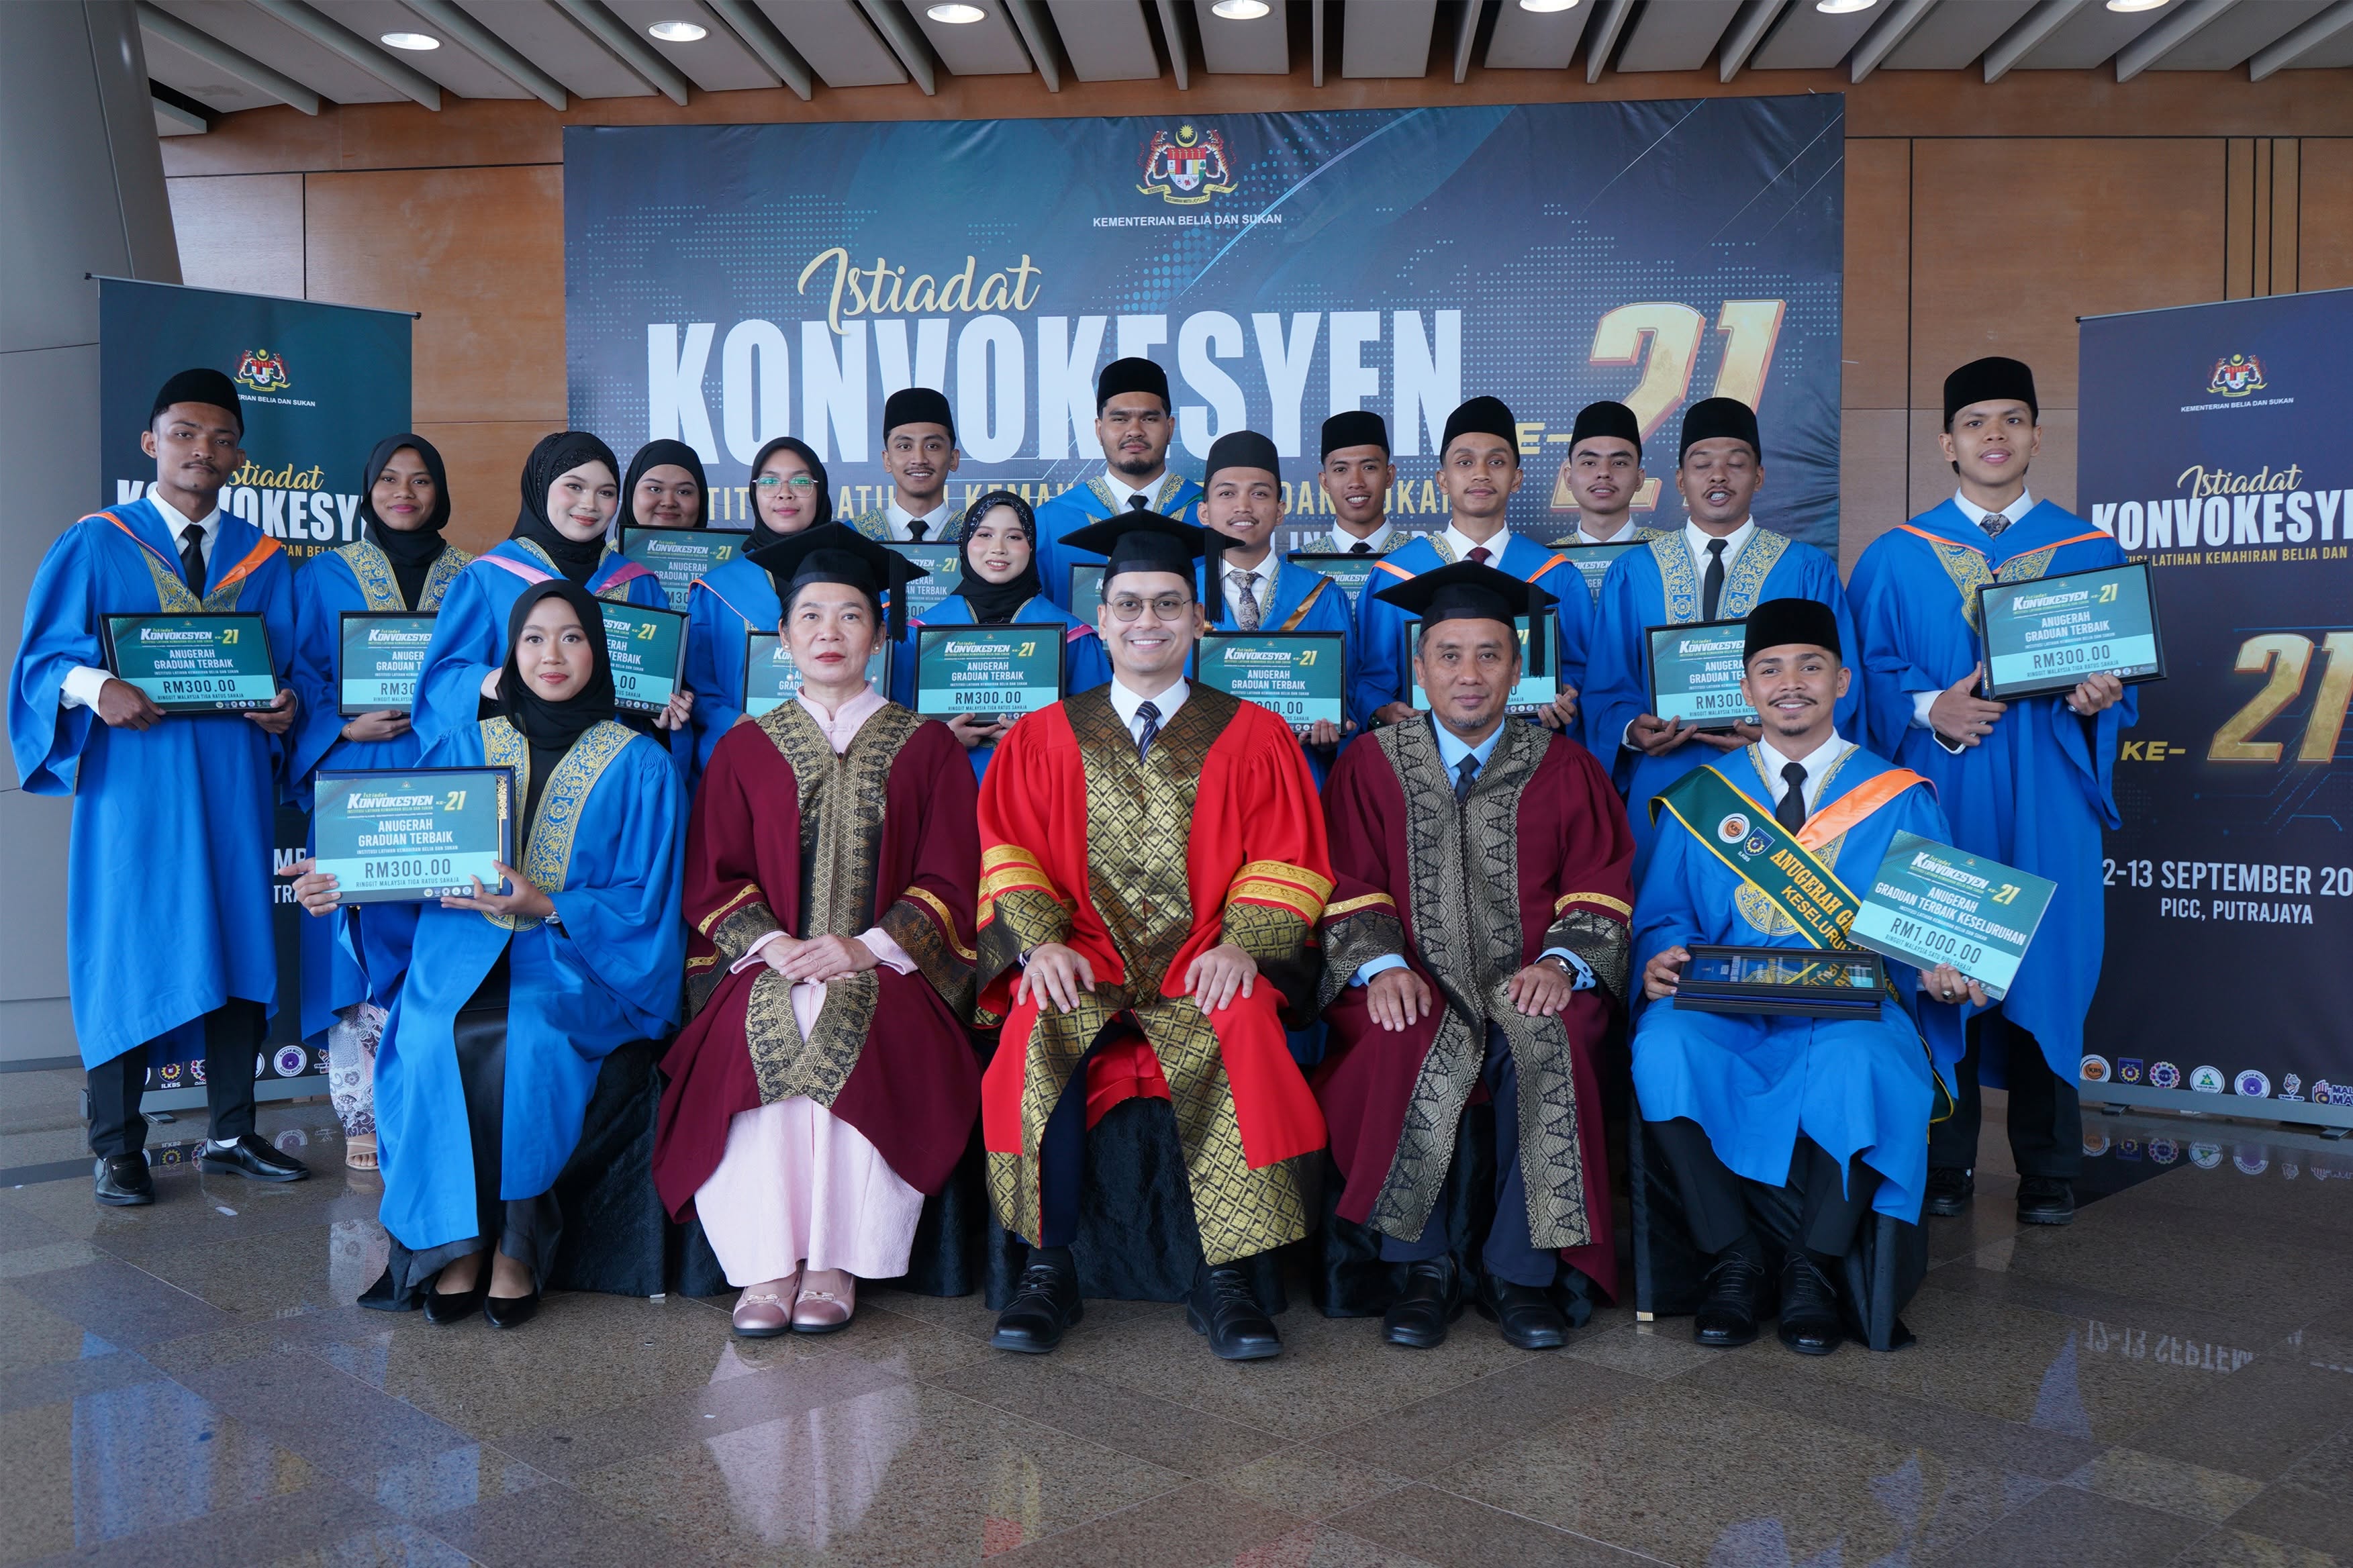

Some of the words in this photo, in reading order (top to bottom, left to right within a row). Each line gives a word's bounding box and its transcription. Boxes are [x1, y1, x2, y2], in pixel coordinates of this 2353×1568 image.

[1093, 216, 1175, 227] KEMENTERIAN
[1178, 215, 1211, 225] BELIA
[1214, 215, 1239, 224] DAN
[1242, 215, 1282, 224] SUKAN
[798, 247, 1041, 336] Istiadat
[2181, 403, 2229, 412] KEMENTERIAN
[229, 460, 325, 491] stiadat
[2177, 464, 2303, 499] Istiadat
[647, 540, 708, 554] KONVOKESYEN
[716, 546, 732, 560] 21
[2152, 551, 2201, 567] LATIHAN
[2206, 549, 2276, 564] KEMAHIRAN
[2283, 548, 2317, 560] BELIA
[2322, 546, 2347, 559] DAN
[668, 562, 707, 572] ANUGERAH
[942, 557, 958, 572] 21
[917, 586, 947, 595] TERBAIK
[2013, 591, 2088, 611] KONVOKESYEN
[2099, 583, 2119, 603] 21
[2042, 611, 2091, 628] ANUGERAH
[140, 628, 212, 640] KONVOKESYEN
[223, 629, 239, 644] 21
[638, 623, 657, 640] 21
[2025, 626, 2068, 642] GRADUAN
[2070, 620, 2109, 636] TERBAIK
[607, 639, 628, 651] ERAH
[945, 642, 1010, 653] KONVOKESYEN
[1018, 642, 1036, 656] 21
[170, 649, 215, 659] ANUGERAH
[392, 651, 424, 660] ANUGER
[608, 650, 641, 665] TERBAIK
[1224, 648, 1291, 660] KONVOKESYEN
[1300, 650, 1318, 666] 21
[2033, 644, 2110, 669] RM300.00
[154, 660, 195, 670] GRADUAN
[197, 659, 234, 669] TERBAIK
[377, 662, 414, 671] GRADUAN
[967, 662, 1009, 671] ANUGERAH
[1705, 660, 1745, 671] ANUGERA
[2048, 667, 2071, 675] MALAYSIA
[952, 672, 988, 681] GRADUAN
[991, 671, 1024, 680] TERBAIK
[1247, 670, 1290, 679] ANUGERAH
[1690, 672, 1729, 683] GRADUAN
[163, 679, 236, 693] RM300.00
[1232, 680, 1269, 689] GRADUAN
[1271, 681, 1305, 689] TERBAIK
[955, 691, 1021, 704] RM300.00
[1696, 693, 1743, 709] RM300
[2121, 741, 2186, 761] KE-
[2207, 632, 2353, 763] 21
[348, 793, 434, 809] KONVOKESYEN
[444, 791, 467, 811] 21
[379, 819, 432, 832] ANUGERAH
[1729, 824, 1741, 834] KBS
[358, 834, 406, 846] GRADUAN
[410, 831, 453, 844] TERBAIK
[365, 859, 451, 878] RM300.00
[1770, 848, 1843, 916] ANUGERAH
[1911, 852, 1990, 889] KONVOKESYEN
[1992, 883, 2021, 905] 21
[2103, 858, 2153, 887] 2-13
[2160, 861, 2311, 895] SEPTEMBER
[1927, 887, 1978, 913] ANUGERAH
[1875, 882, 1918, 906] GRADUAN
[1918, 897, 1957, 920] TERBAIK
[1956, 912, 2027, 946] KESELURUHAN
[2160, 897, 2206, 922] PICC,
[2213, 901, 2313, 924] PUTRAJAYA
[1890, 918, 1982, 964] RM1,000.00
[1885, 934, 1905, 946] RINGGIT
[1905, 940, 1928, 956] MALAYSIA
[1928, 949, 1941, 960] SATU
[1953, 959, 1972, 973] SAHAJA
